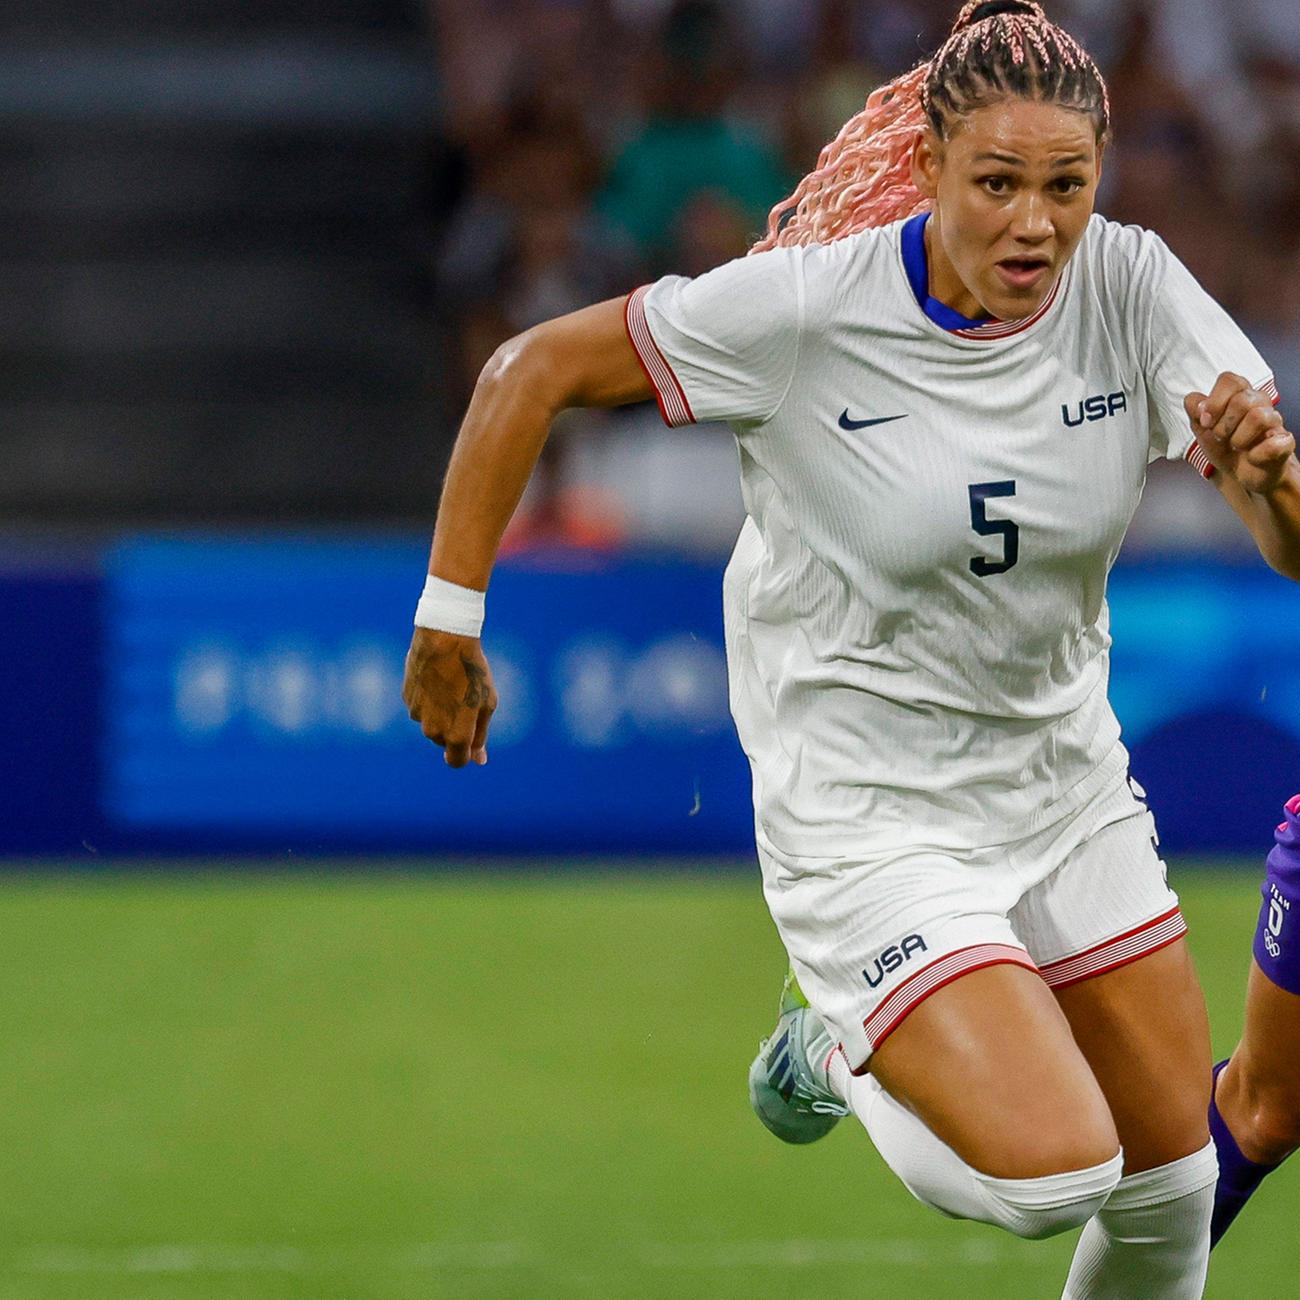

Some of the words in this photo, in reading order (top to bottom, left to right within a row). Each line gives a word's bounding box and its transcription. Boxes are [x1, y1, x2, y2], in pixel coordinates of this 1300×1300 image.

[1061, 391, 1127, 427] USA
[967, 479, 1019, 577] 5
[1270, 883, 1290, 910] TEAM
[862, 934, 928, 988] USA
